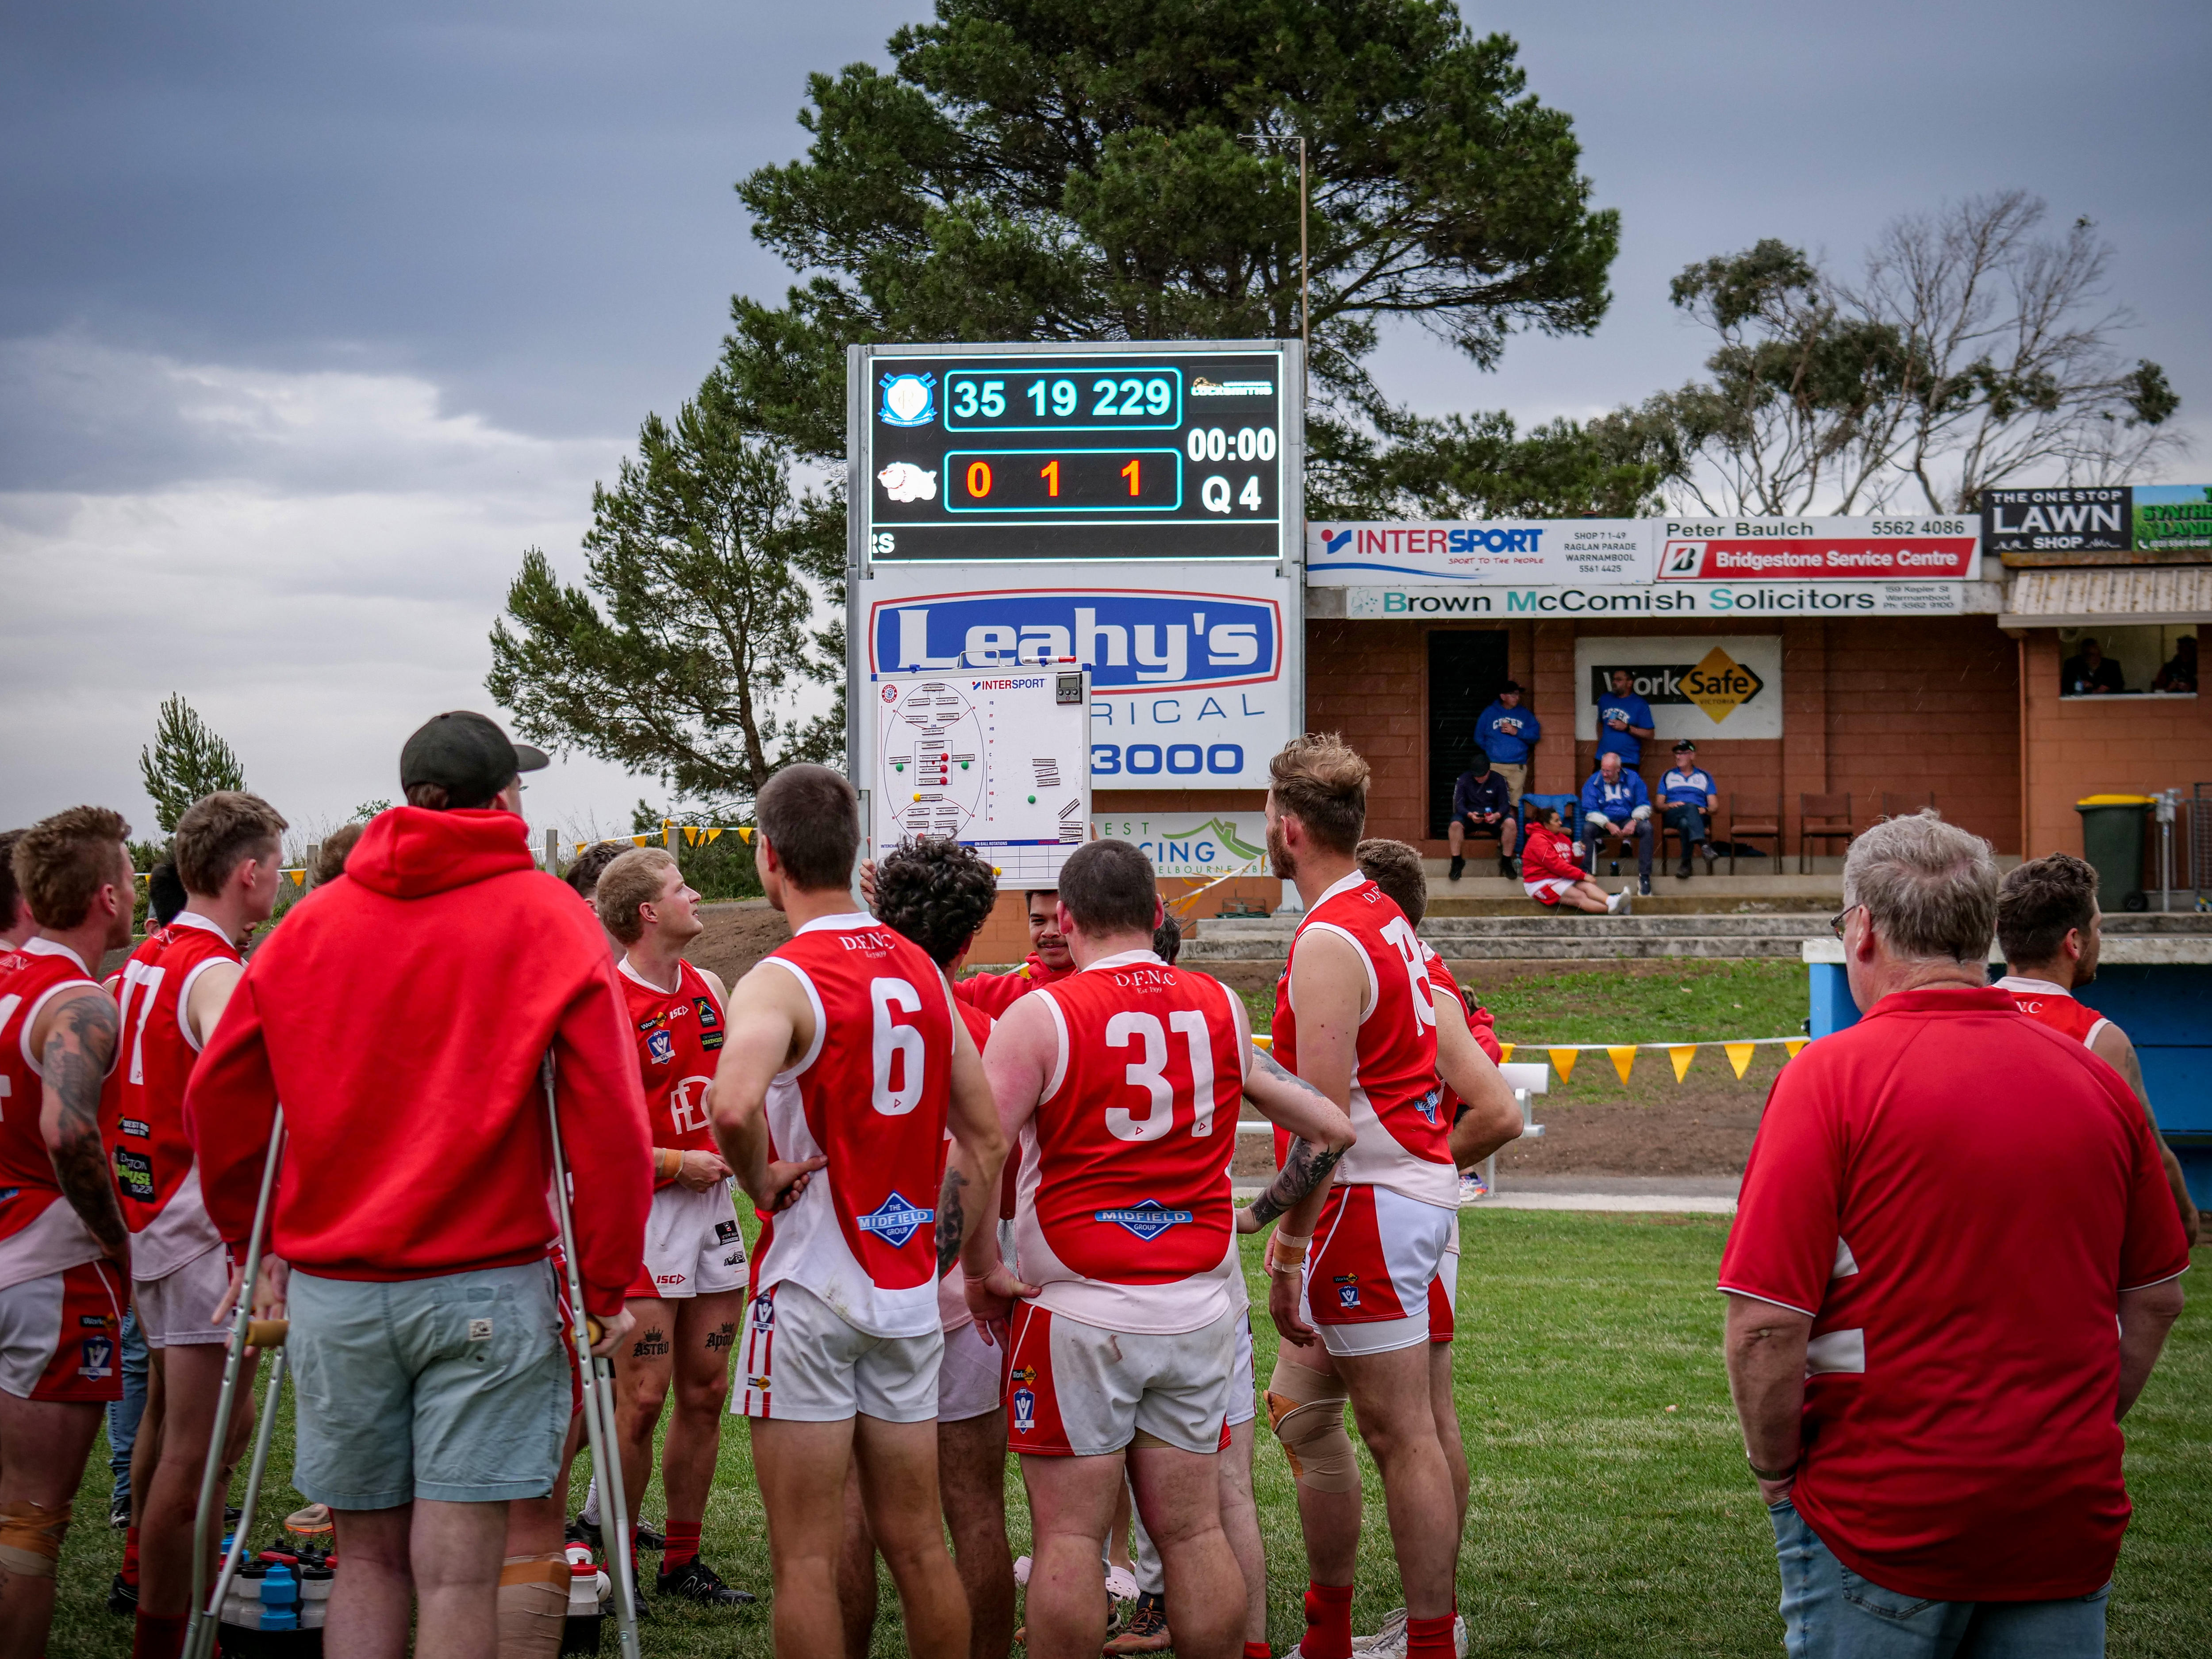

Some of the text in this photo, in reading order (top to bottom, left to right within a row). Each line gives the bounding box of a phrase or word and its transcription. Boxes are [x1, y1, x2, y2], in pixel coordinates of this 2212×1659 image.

[954, 381, 1005, 417] 35
[1027, 380, 1078, 416] 19
[1093, 379, 1172, 416] 229
[1188, 428, 1276, 461] 00:00
[967, 461, 1141, 498] 0 1 1
[1992, 489, 2123, 503] THE ONE STOP
[1993, 504, 2123, 534] LAWN
[1667, 521, 1965, 537] Peter Baulch 5562 4086
[1357, 528, 1543, 554] INTERSPORT
[2033, 536, 2084, 550] SHOP
[1716, 550, 1959, 571] Bridgestone Service Centre
[1383, 588, 1875, 613] Brown McComish Solicitors
[898, 607, 1259, 680] Leahy's
[982, 679, 1045, 690] INTERSPORT
[1106, 822, 1149, 835] EST
[1113, 970, 1177, 987] D.F.N.C
[870, 977, 925, 1116] 6
[1106, 1010, 1215, 1141] 31
[860, 1210, 929, 1228] MIDFIELD
[1102, 1212, 1186, 1221] MIDFIELD
[886, 1226, 908, 1236] GROUP
[657, 1275, 677, 1284] ISC
